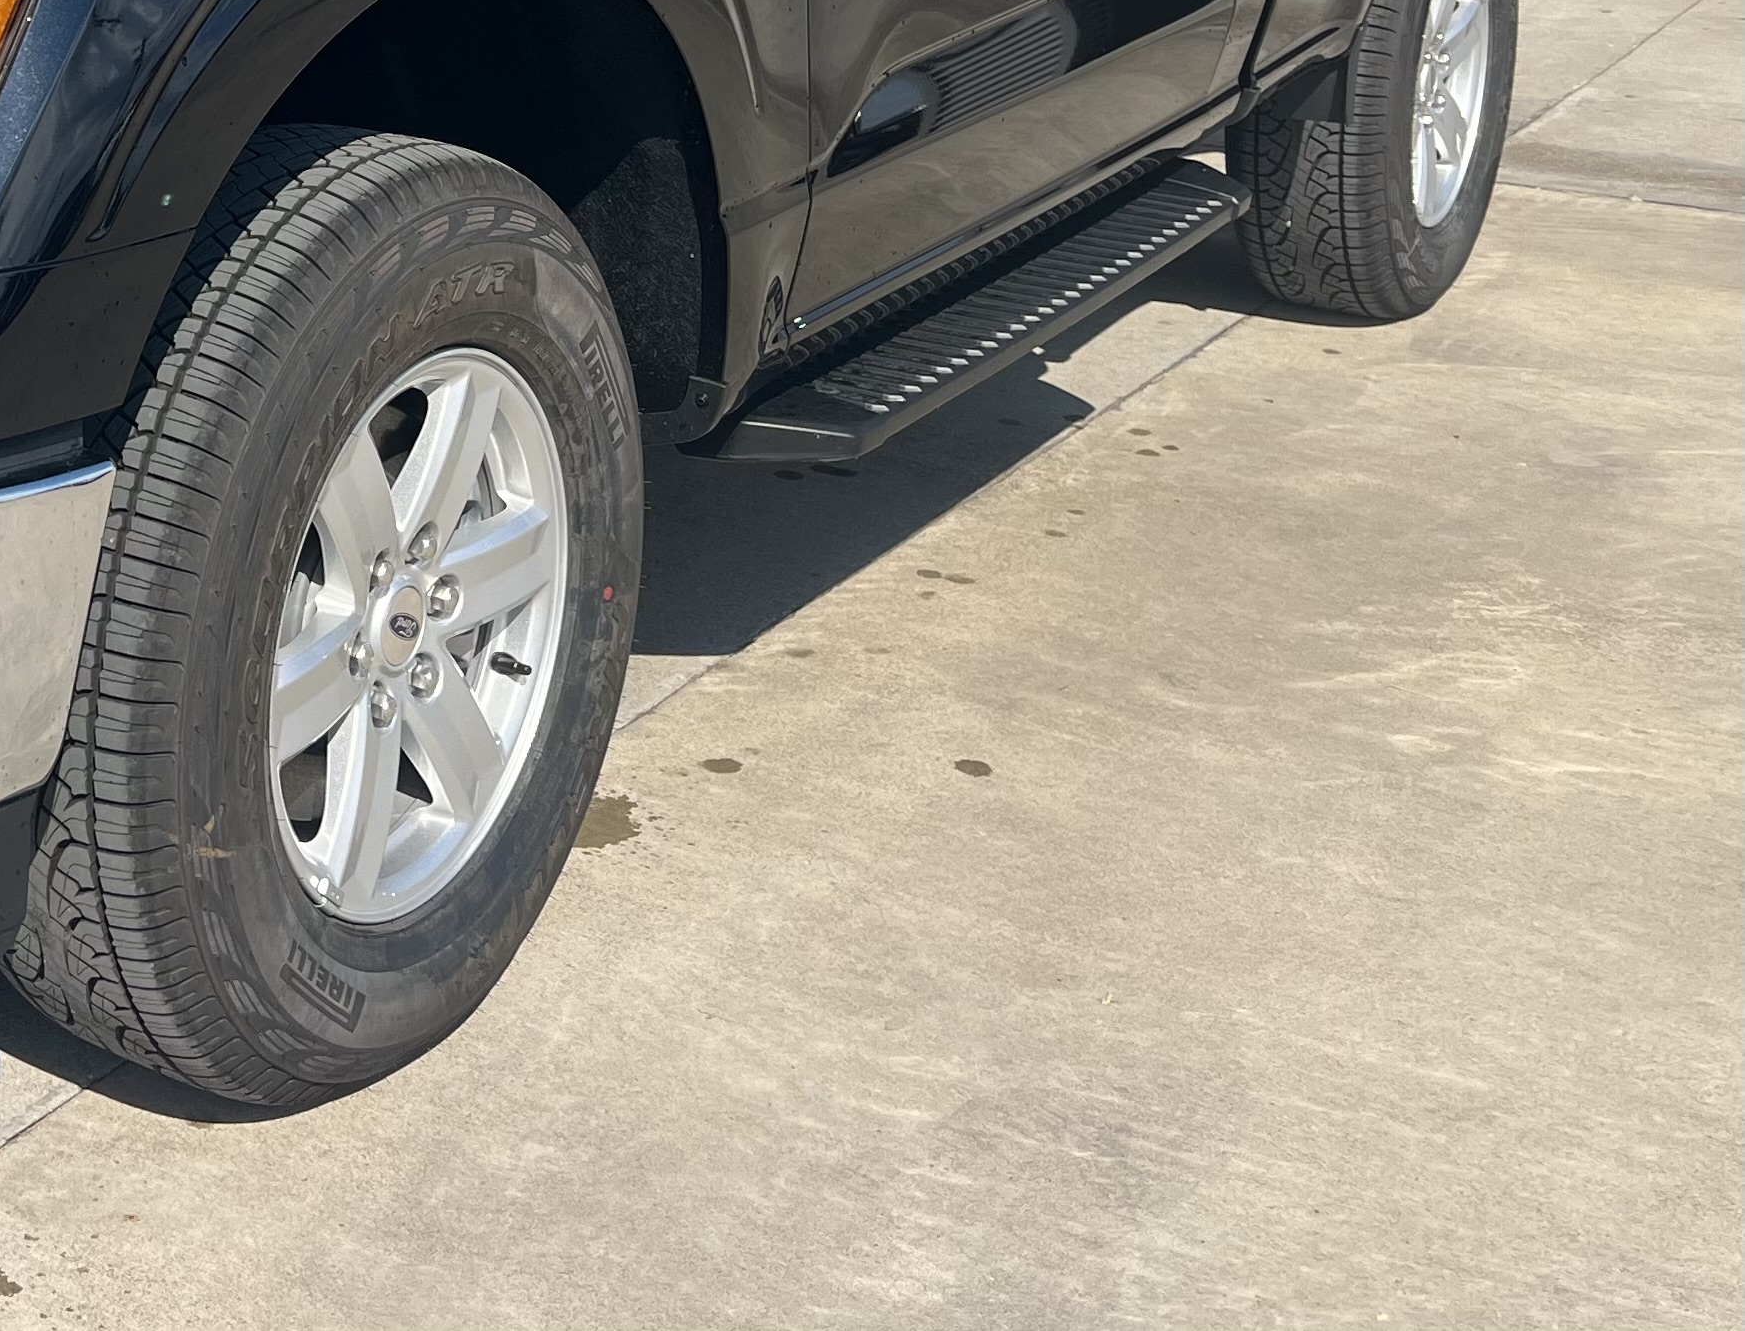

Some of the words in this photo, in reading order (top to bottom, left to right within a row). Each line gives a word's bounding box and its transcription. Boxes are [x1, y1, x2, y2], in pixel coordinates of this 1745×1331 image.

[413, 259, 515, 329] ATR
[579, 319, 631, 452] PIRELLI
[279, 938, 366, 1034] PIRELLI
